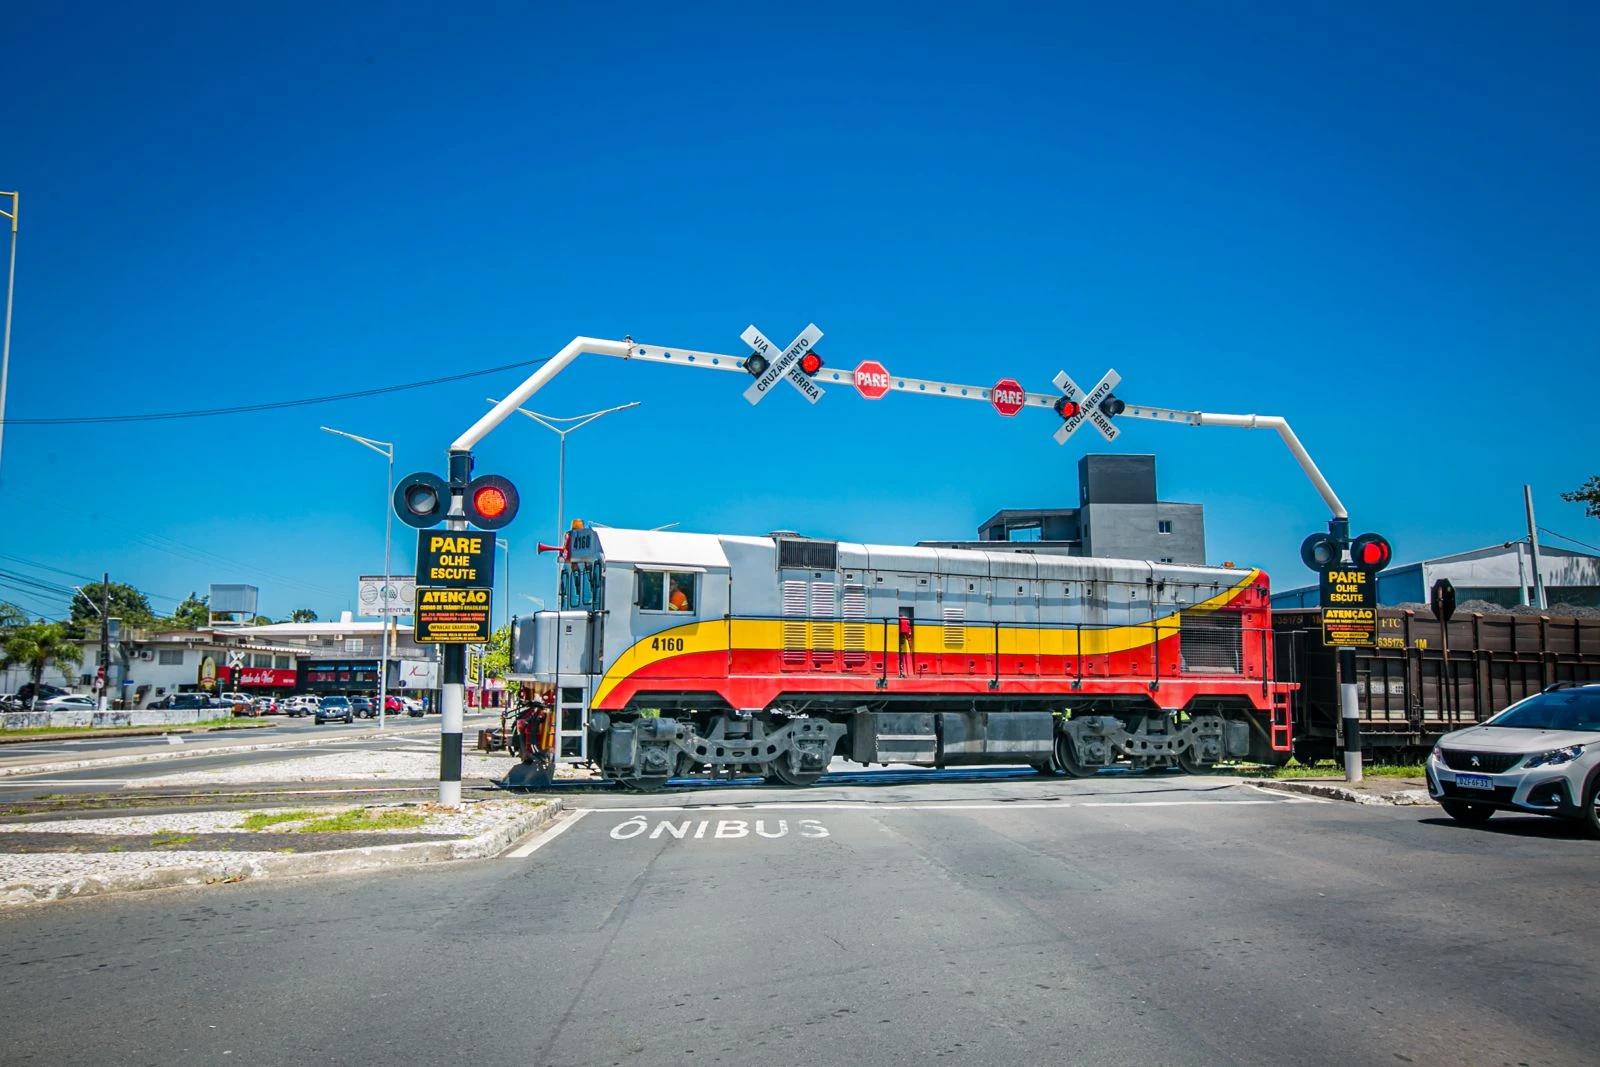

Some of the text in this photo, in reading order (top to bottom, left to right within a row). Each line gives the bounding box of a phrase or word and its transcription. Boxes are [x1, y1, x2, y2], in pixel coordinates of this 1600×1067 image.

[753, 336, 769, 353] VIA
[756, 338, 809, 392] CRUZAMENTO
[857, 372, 888, 388] PARE
[1062, 381, 1076, 397] VIA
[994, 389, 1022, 405] PARE
[1065, 382, 1110, 433] CRUZAMENTO
[430, 537, 482, 554] PARE
[573, 535, 591, 549] 4160
[439, 554, 470, 567] OLHE
[430, 567, 477, 580] ESCUTE
[1328, 571, 1366, 584] PARE
[1336, 584, 1358, 593] OLHE
[423, 590, 487, 606] ATENÇÃO
[1330, 593, 1364, 602] ESCUTE
[1326, 609, 1373, 620] ATENÇÃO
[651, 637, 684, 651] 4160
[1377, 637, 1405, 648] 635175
[609, 815, 831, 840] ÔNIBUS
